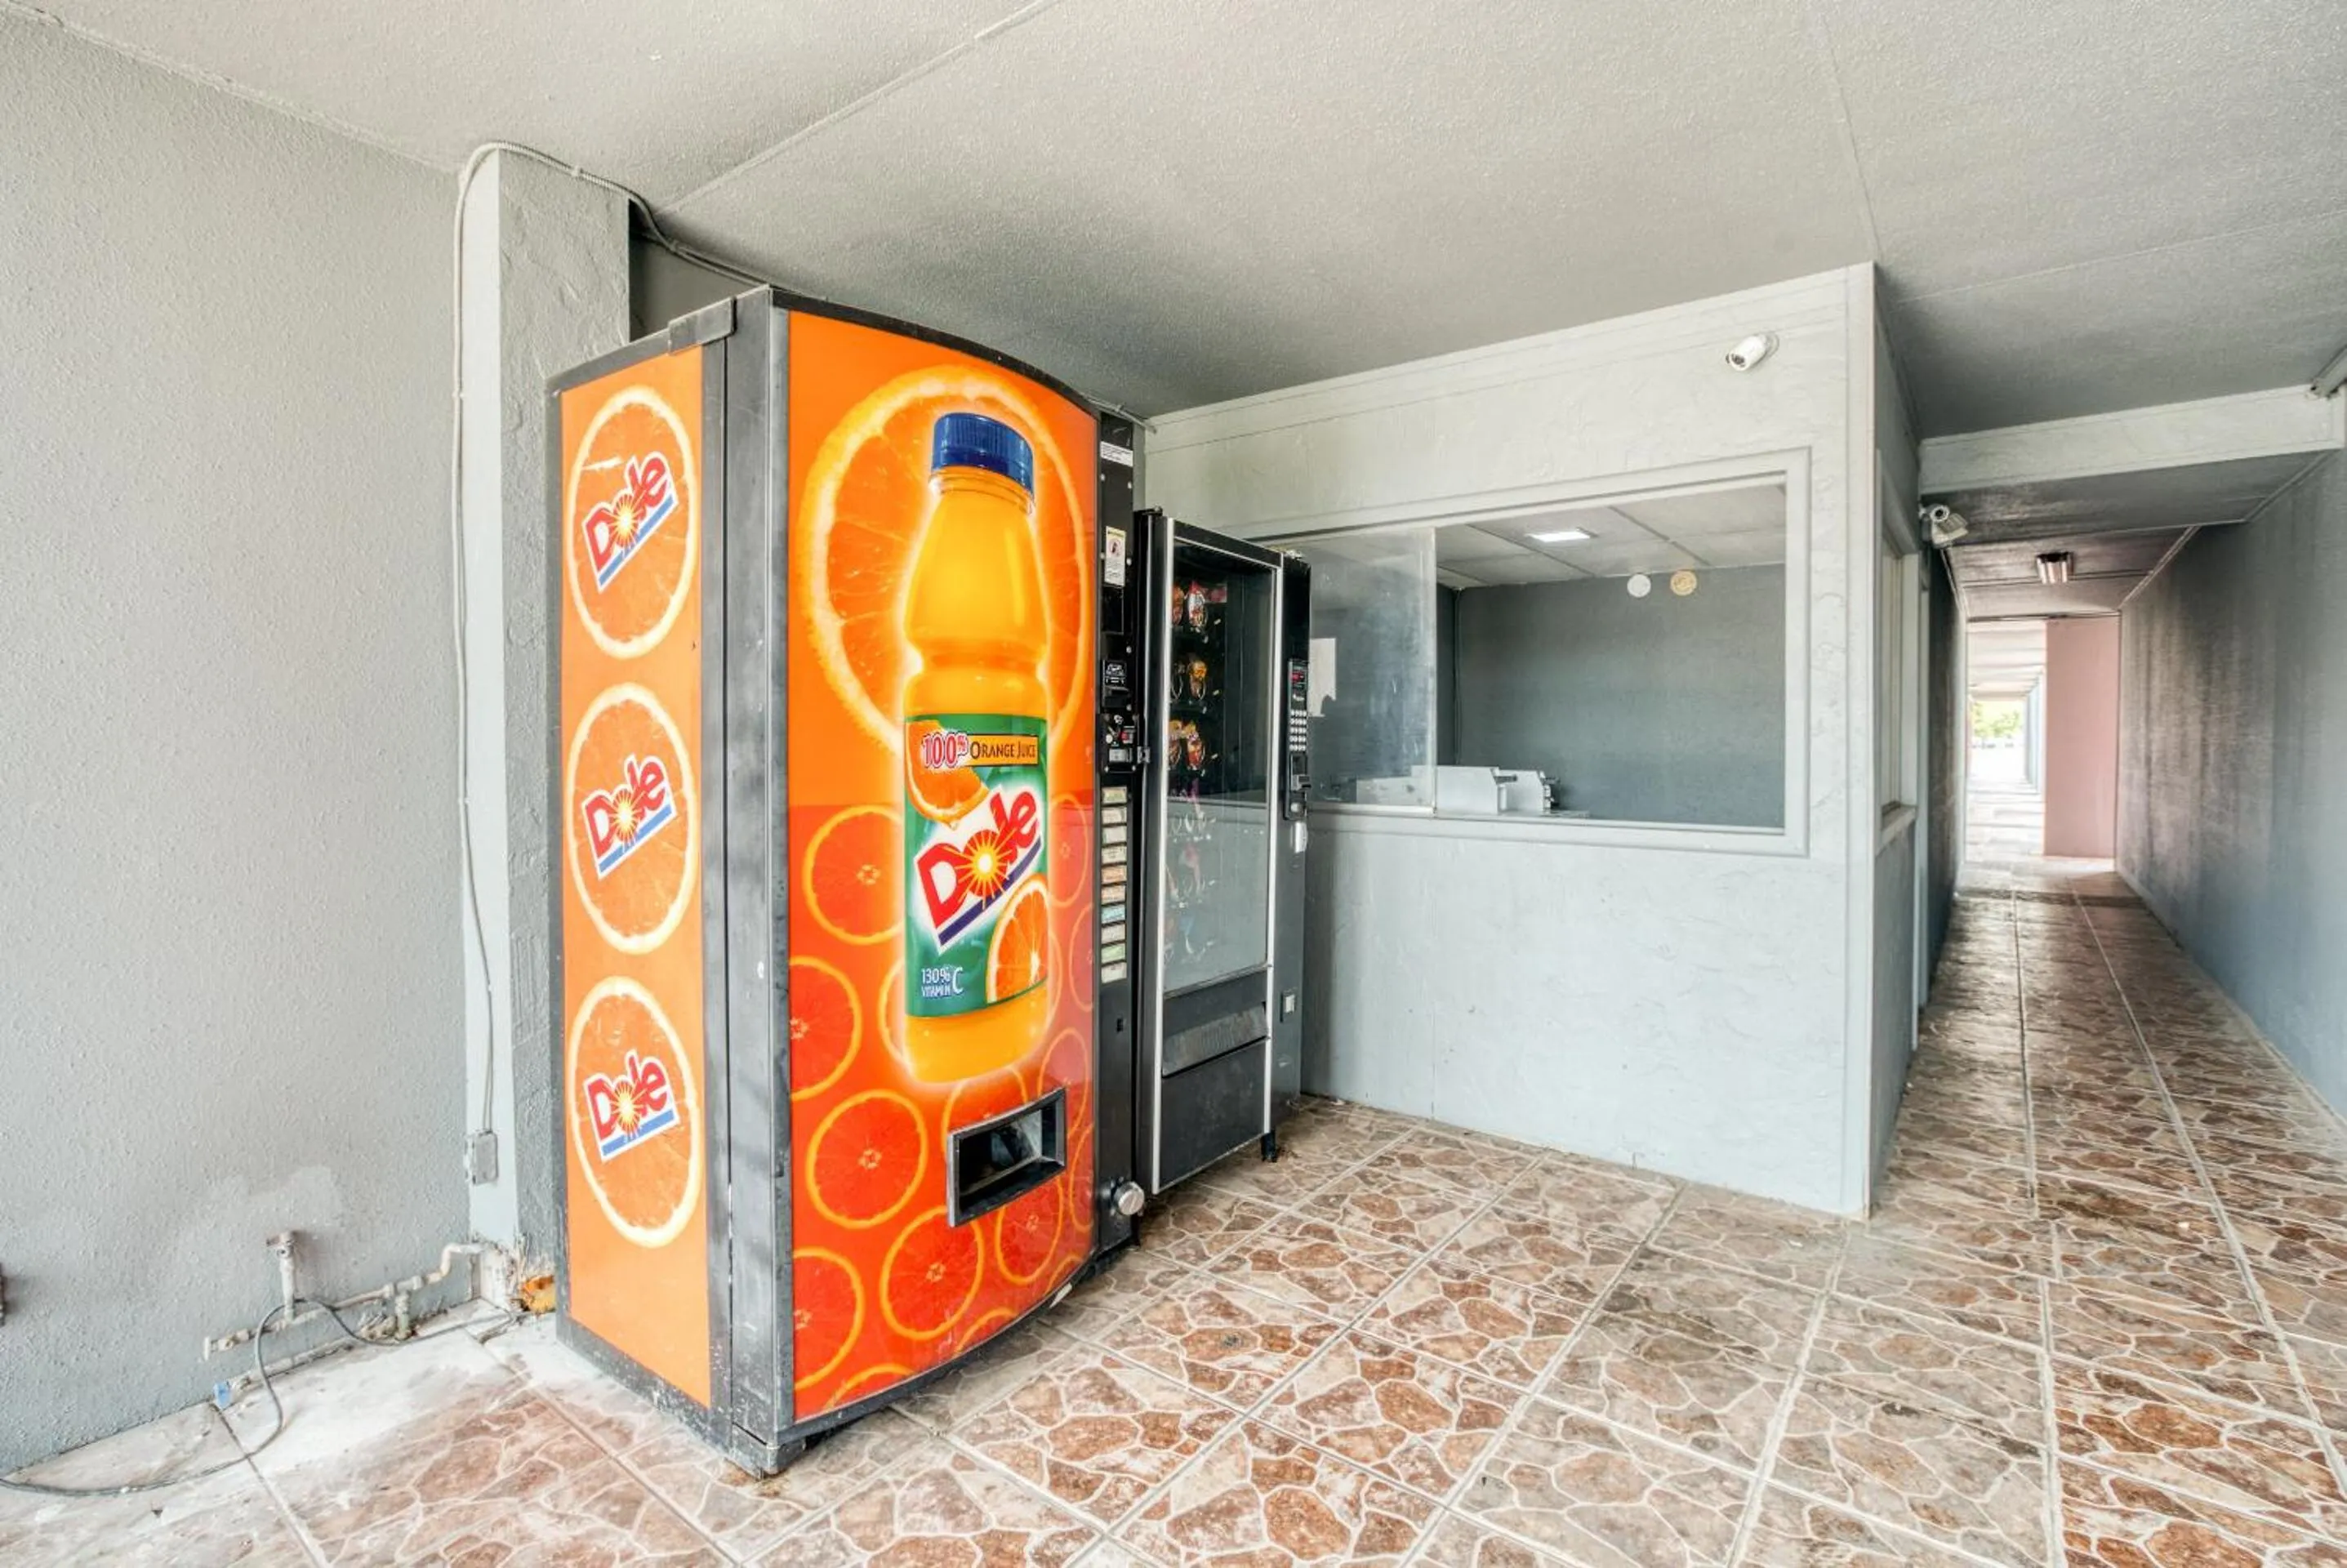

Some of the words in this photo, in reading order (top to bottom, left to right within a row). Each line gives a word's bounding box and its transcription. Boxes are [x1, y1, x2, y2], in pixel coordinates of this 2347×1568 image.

[584, 454, 668, 572] Dole
[923, 733, 967, 767] 100%
[586, 760, 666, 858] Dole
[916, 791, 1039, 929] Dole
[920, 968, 951, 985] 130%
[952, 966, 964, 995] C
[587, 1055, 667, 1141] Dole
